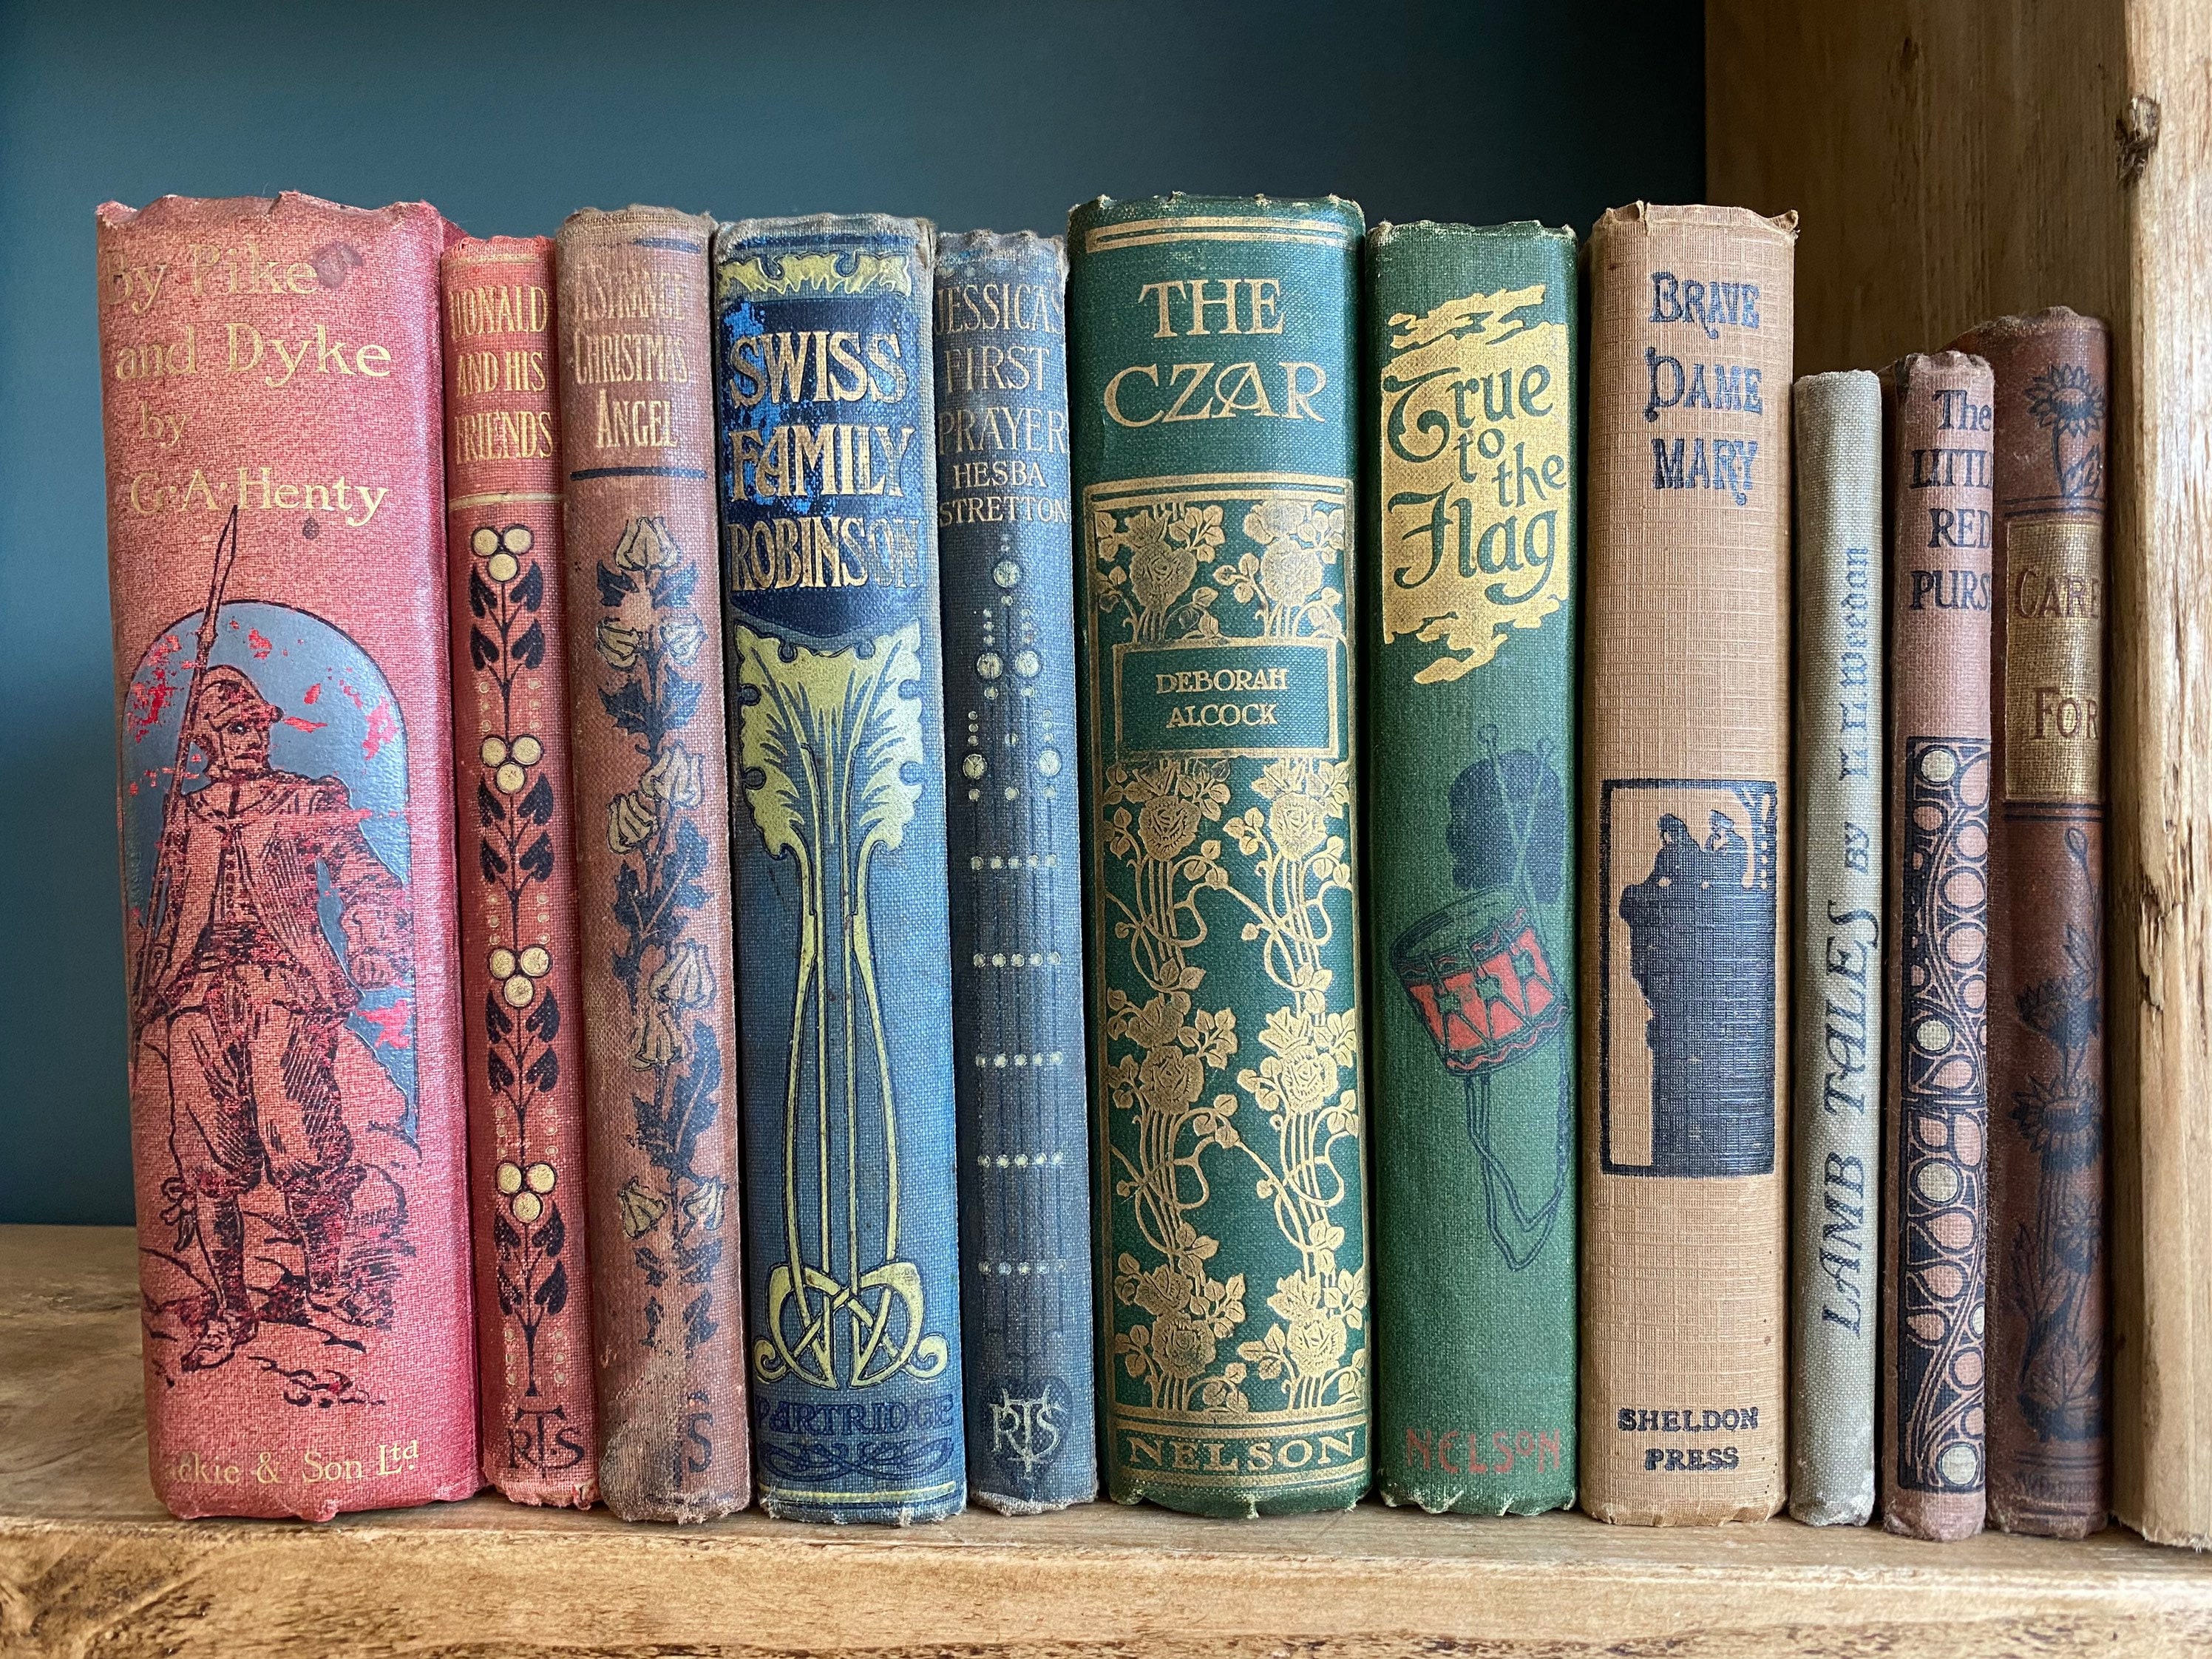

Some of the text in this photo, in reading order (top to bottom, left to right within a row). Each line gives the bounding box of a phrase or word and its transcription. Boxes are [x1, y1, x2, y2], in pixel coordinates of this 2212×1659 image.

[188, 242, 319, 296] Pike
[1139, 278, 1286, 339] THE
[1648, 271, 1760, 339] BRAVE
[116, 322, 392, 388] and Dyke
[456, 351, 547, 397] AND HIS
[728, 330, 909, 409] SWISS
[944, 345, 1051, 393] FIRST
[1103, 361, 1327, 427] CZAR
[1643, 346, 1763, 423] DAME
[1931, 389, 1992, 432] The
[138, 400, 191, 449] by
[455, 410, 554, 465] FRIENDS
[596, 387, 679, 449] ANGEL
[937, 407, 1068, 456] PRAYER
[1382, 364, 1554, 463] True
[728, 423, 917, 503] FAMILY
[951, 460, 1048, 489] HESBA
[1453, 427, 1505, 484] to
[1491, 441, 1567, 508] the
[1651, 437, 1758, 506] MARY
[1908, 448, 1994, 489] LITTL
[939, 495, 1069, 527] STRETTON
[1927, 507, 1992, 549] RED
[727, 516, 920, 591] ROBINSON
[1387, 482, 1558, 605] Flag
[1908, 569, 1991, 611] PURS
[1156, 668, 1289, 695] DEBORAH
[1165, 703, 1280, 728] ALCOCK
[2028, 686, 2099, 740] FOR
[1844, 821, 1870, 876] BY
[1824, 899, 1880, 1117] TALES
[1818, 1152, 1865, 1340] LAMB
[755, 1394, 954, 1436] PARTRIDGE
[1617, 1405, 1759, 1433] SHELDON
[257, 1451, 282, 1484] &
[302, 1452, 364, 1483] Son
[1126, 1430, 1356, 1473] NELSON
[1407, 1428, 1561, 1475] NELSON
[1643, 1446, 1740, 1471] PRESS
